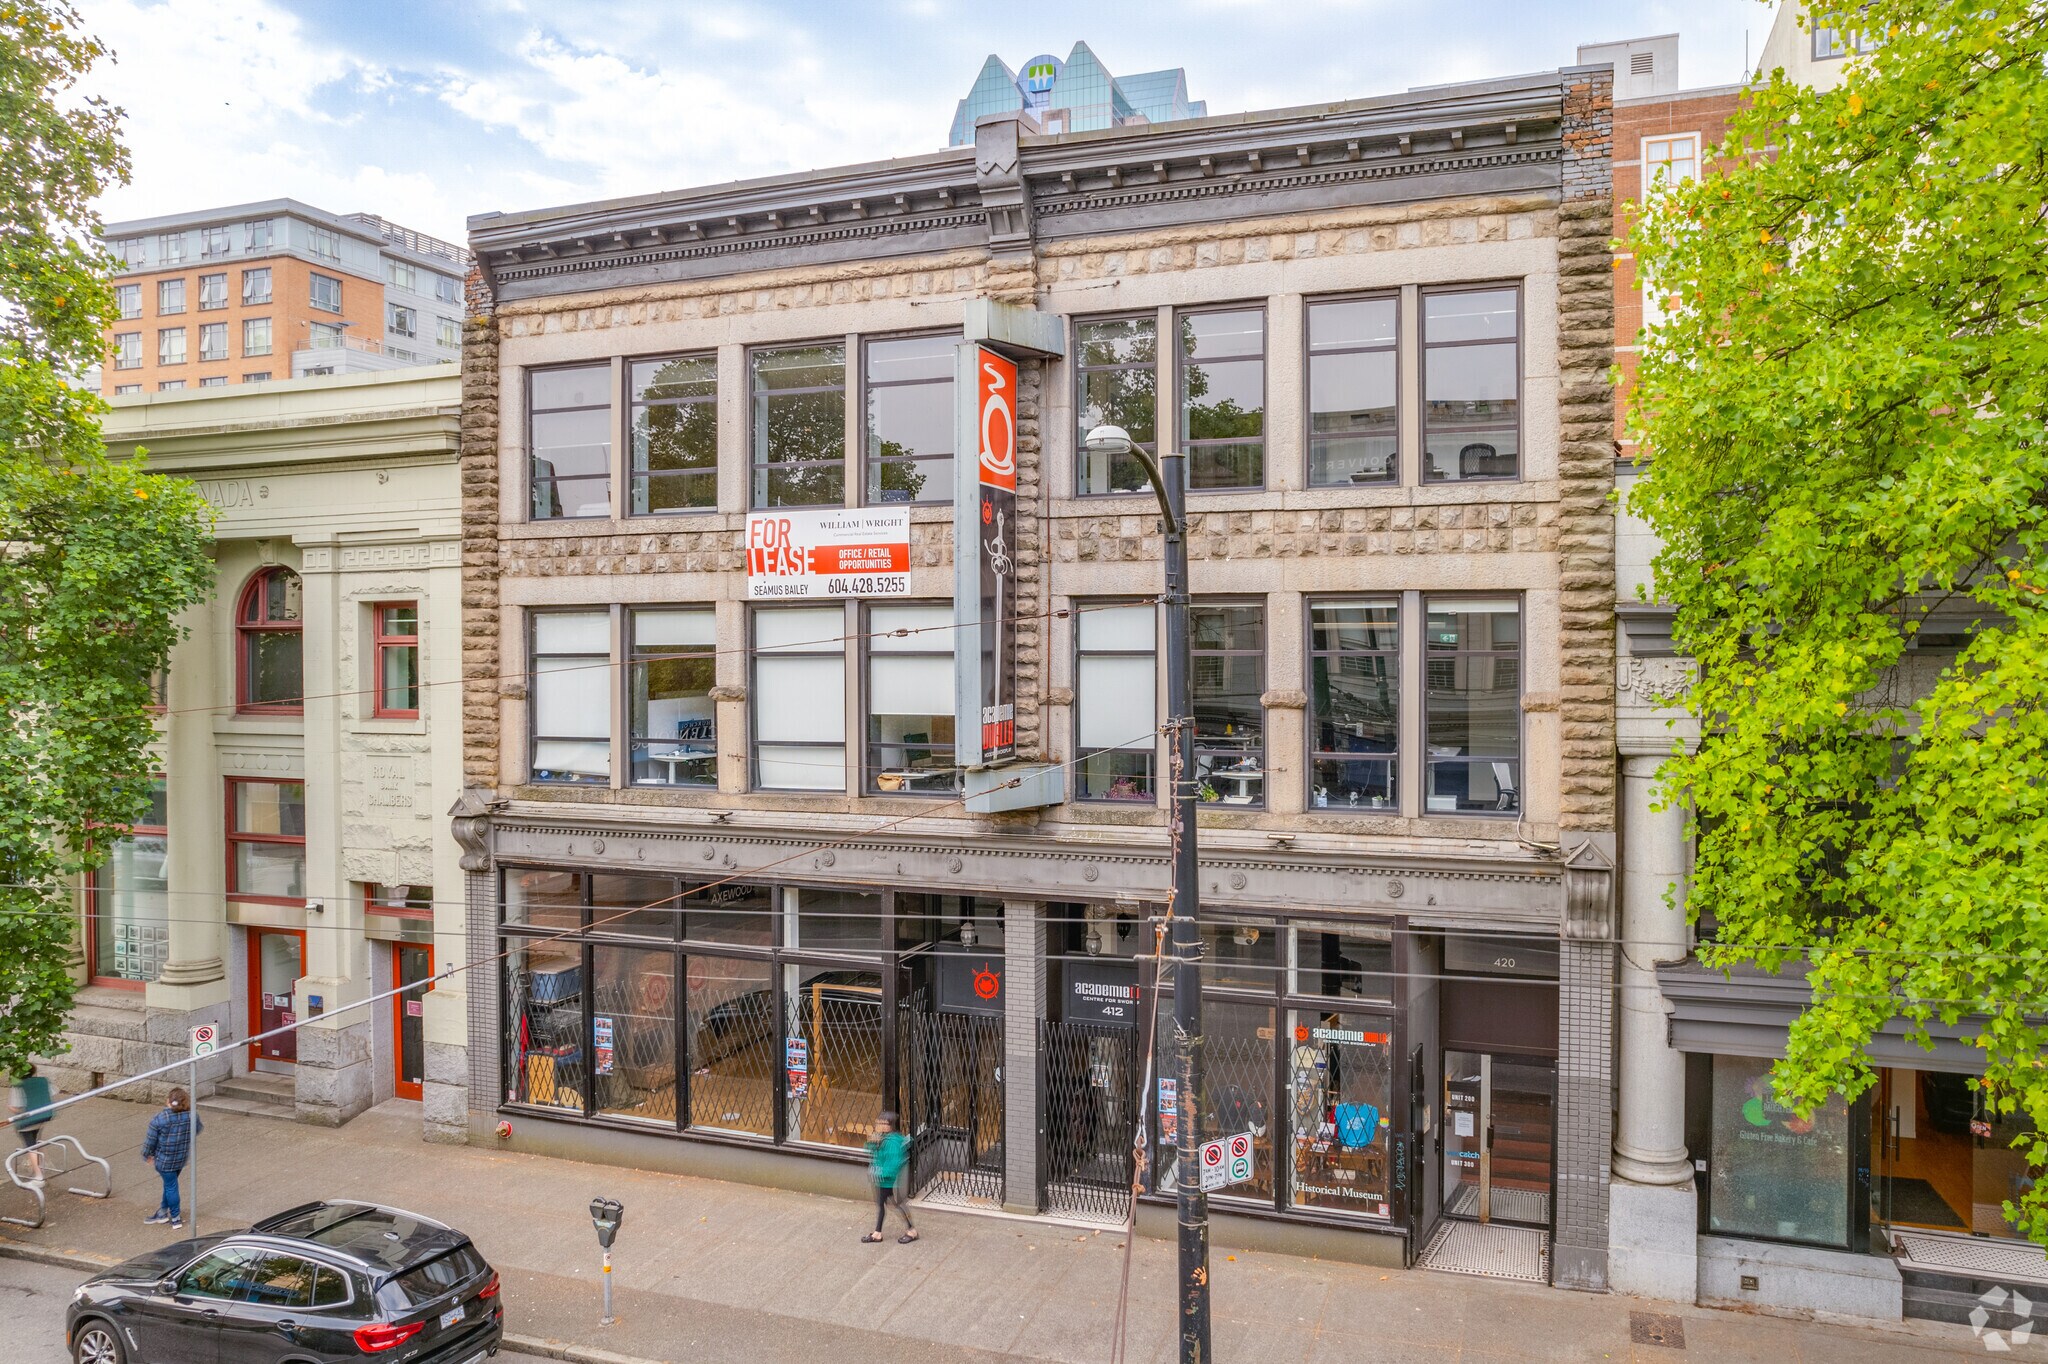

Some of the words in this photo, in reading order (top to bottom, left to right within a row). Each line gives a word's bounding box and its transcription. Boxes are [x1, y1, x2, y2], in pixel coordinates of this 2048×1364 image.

[820, 520, 859, 529] WILLIAM
[865, 518, 903, 527] WRIGHT
[751, 518, 791, 548] FOR
[838, 548, 862, 559] OFFICE
[868, 547, 892, 558] RETAIL
[752, 546, 816, 576] LEASE
[838, 558, 892, 570] OPPORTUNITIES
[754, 585, 783, 596] SEAMUS
[784, 584, 809, 595] BAILEY
[828, 576, 905, 594] 604.428.5255
[373, 766, 405, 779] ROYAL
[369, 794, 412, 807] CHAMBERS
[1494, 958, 1515, 968] 420
[1102, 1006, 1124, 1016] 412
[1740, 1130, 1759, 1140] Gluten
[1760, 1132, 1774, 1142] Free
[1774, 1133, 1796, 1145] Bakery
[1450, 1159, 1463, 1167] UNIT
[1463, 1160, 1475, 1168] 300
[1296, 1181, 1340, 1196] Historical
[1341, 1186, 1383, 1201] Museum
